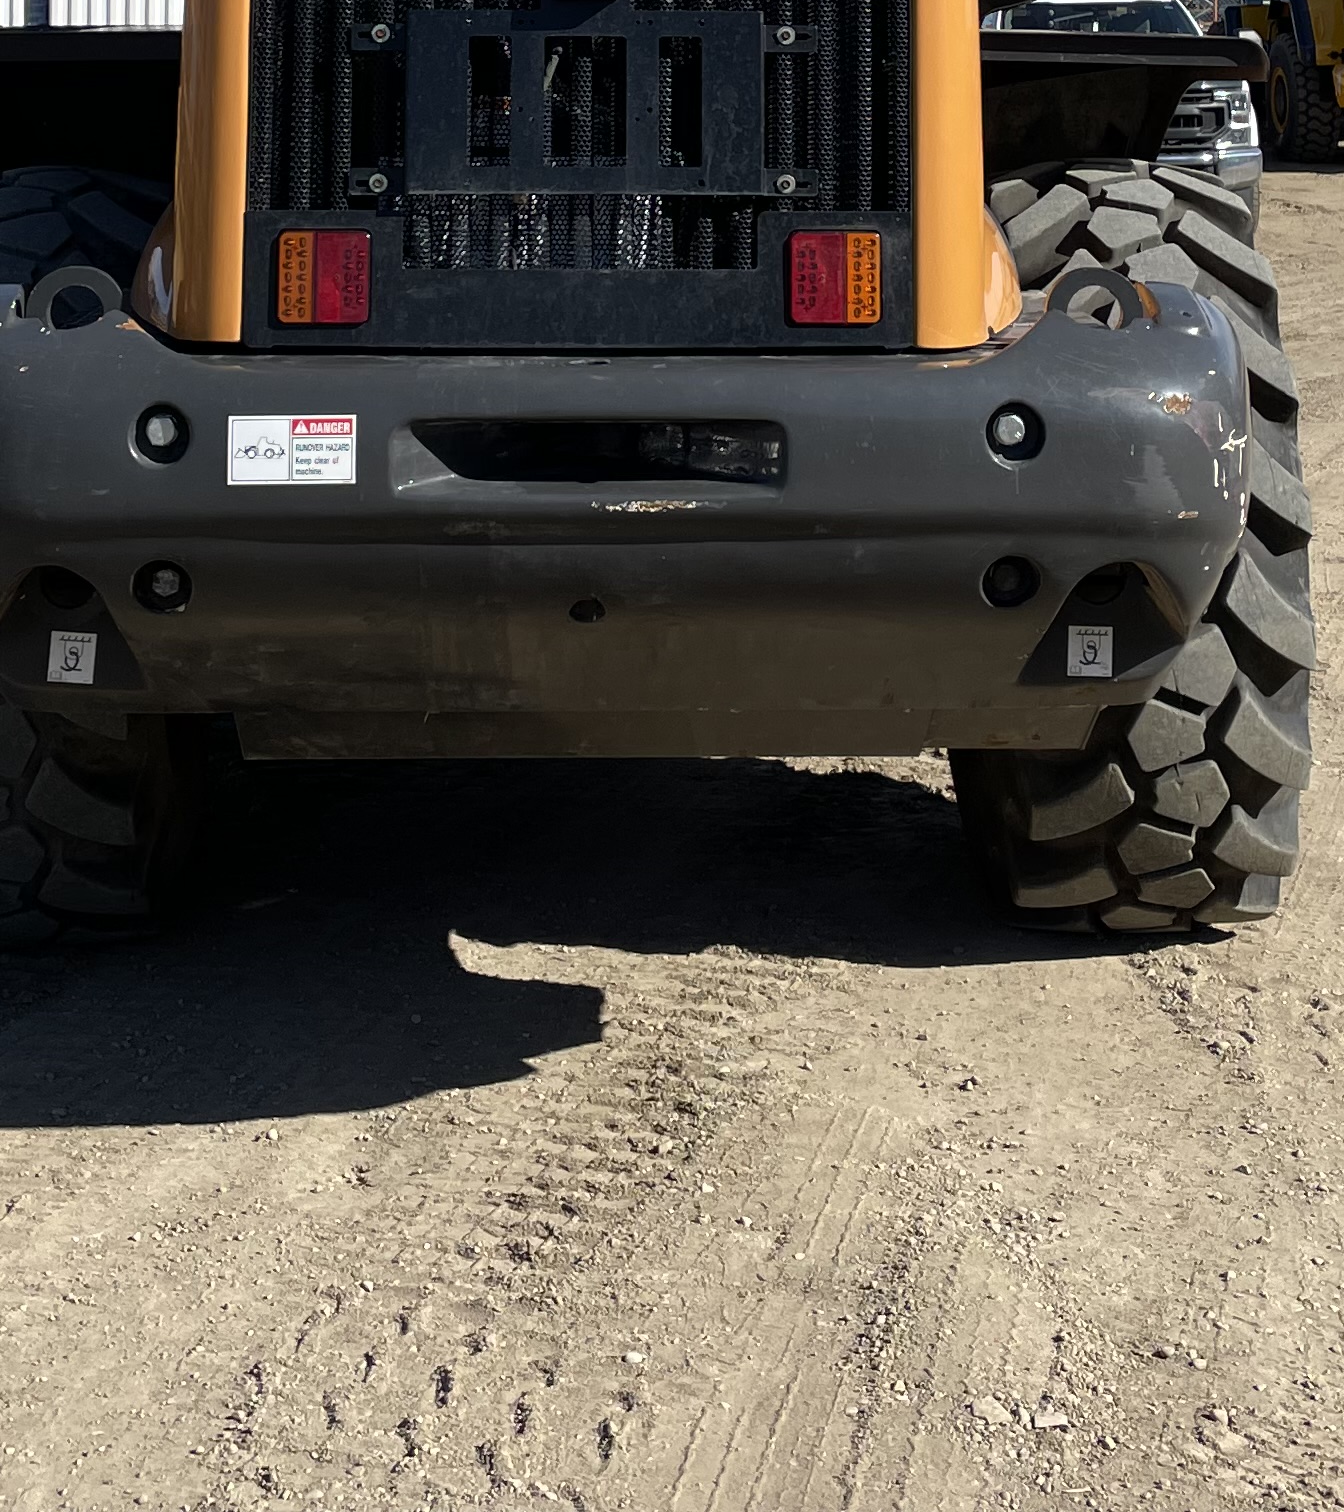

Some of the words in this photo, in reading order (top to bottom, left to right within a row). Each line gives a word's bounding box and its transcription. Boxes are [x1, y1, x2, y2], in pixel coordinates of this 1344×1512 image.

[309, 421, 351, 434] DANGER
[295, 443, 324, 452] RUNOVER
[325, 443, 351, 452] HAZARD
[295, 456, 312, 466] Keep
[314, 456, 330, 465] clear
[332, 456, 340, 465] of
[295, 467, 324, 476] machine.
